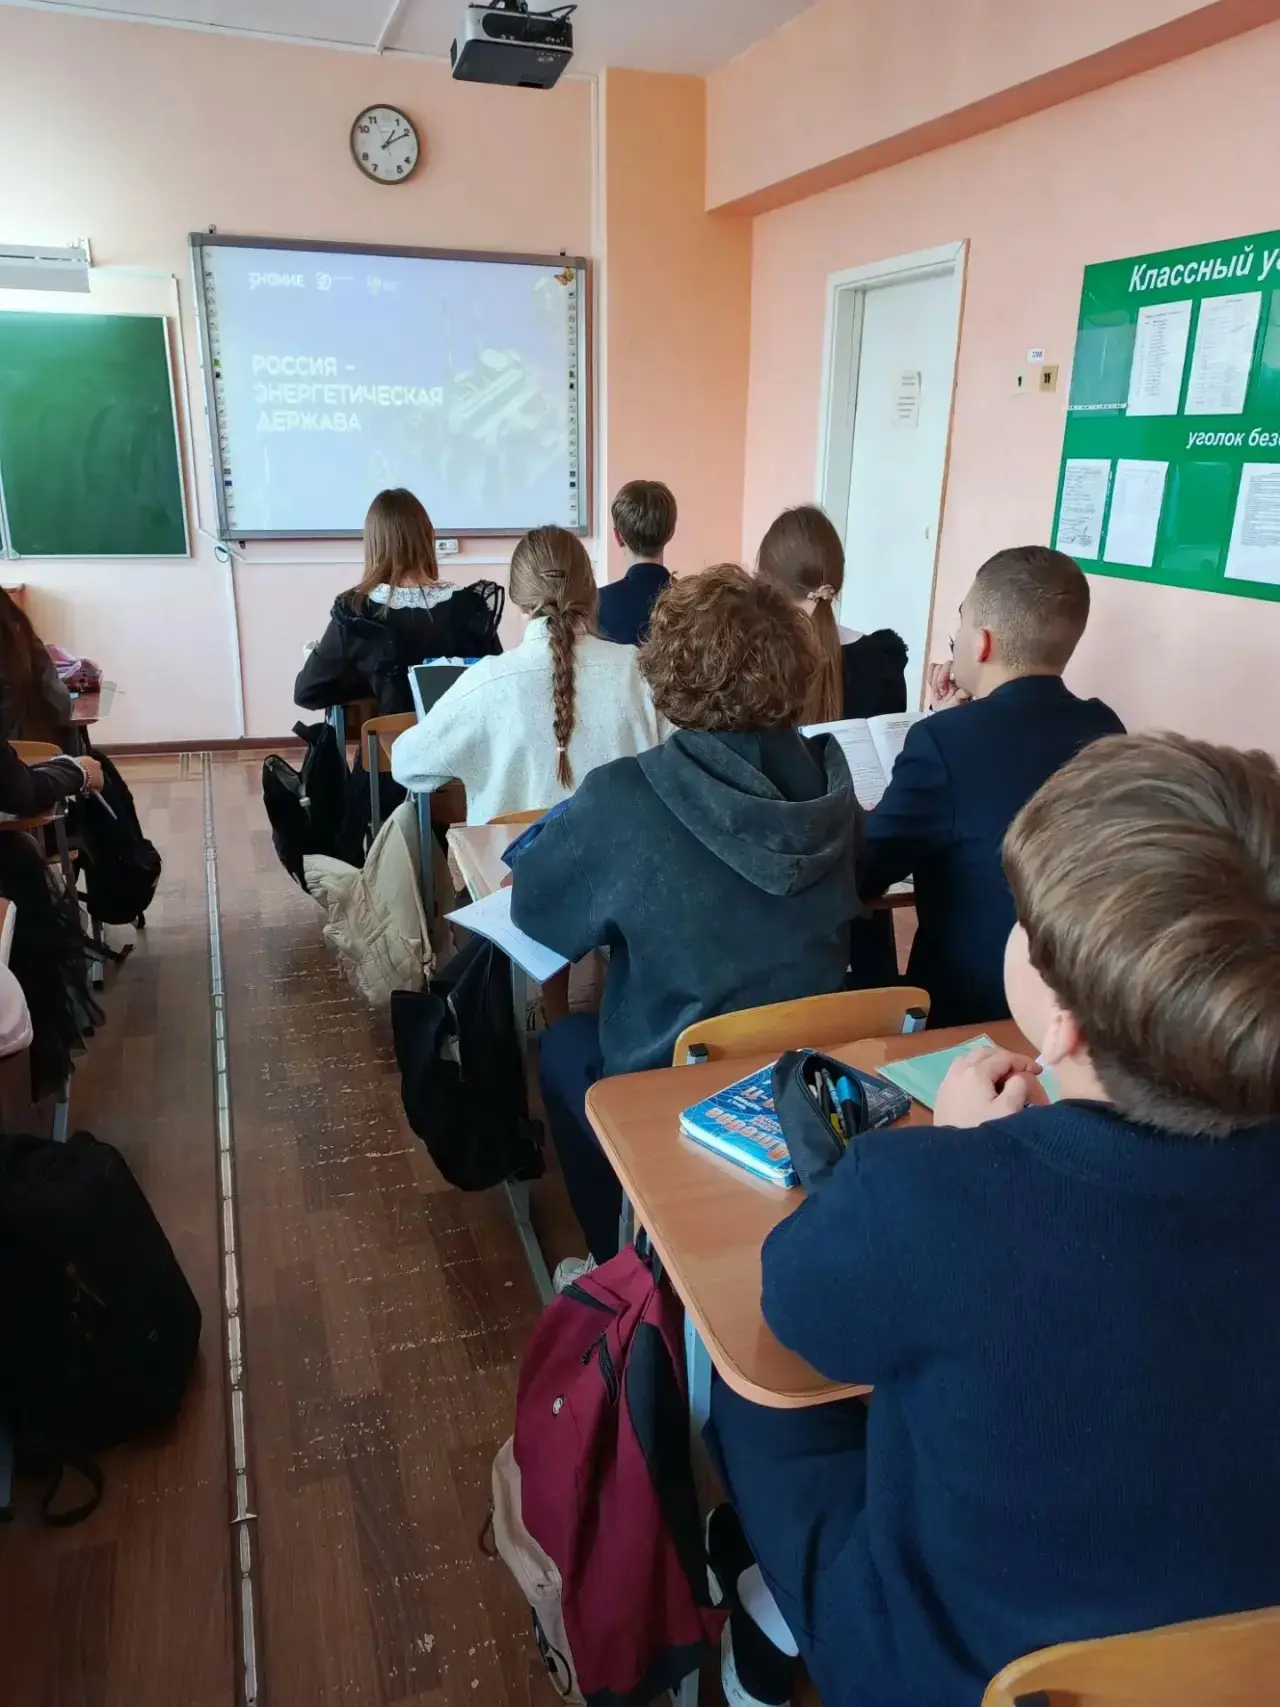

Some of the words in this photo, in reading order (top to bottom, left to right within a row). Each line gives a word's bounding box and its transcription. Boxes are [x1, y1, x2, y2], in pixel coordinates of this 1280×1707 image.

[368, 116, 377, 124] 11
[395, 118, 400, 127] 1
[358, 124, 370, 133] 10
[403, 128, 410, 136] 2
[404, 156, 411, 164] 4
[371, 163, 378, 172] 7
[396, 165, 404, 174] 5
[1128, 244, 1254, 293] Классный
[1257, 247, 1280, 282] у
[252, 354, 338, 377] РОССИЯ
[252, 383, 444, 407] ЭНЕРГЕТИЧЕСКАЯ
[256, 410, 362, 434] ДЕРЖАВА
[1185, 431, 1246, 450] уголок
[1248, 427, 1280, 448] без
